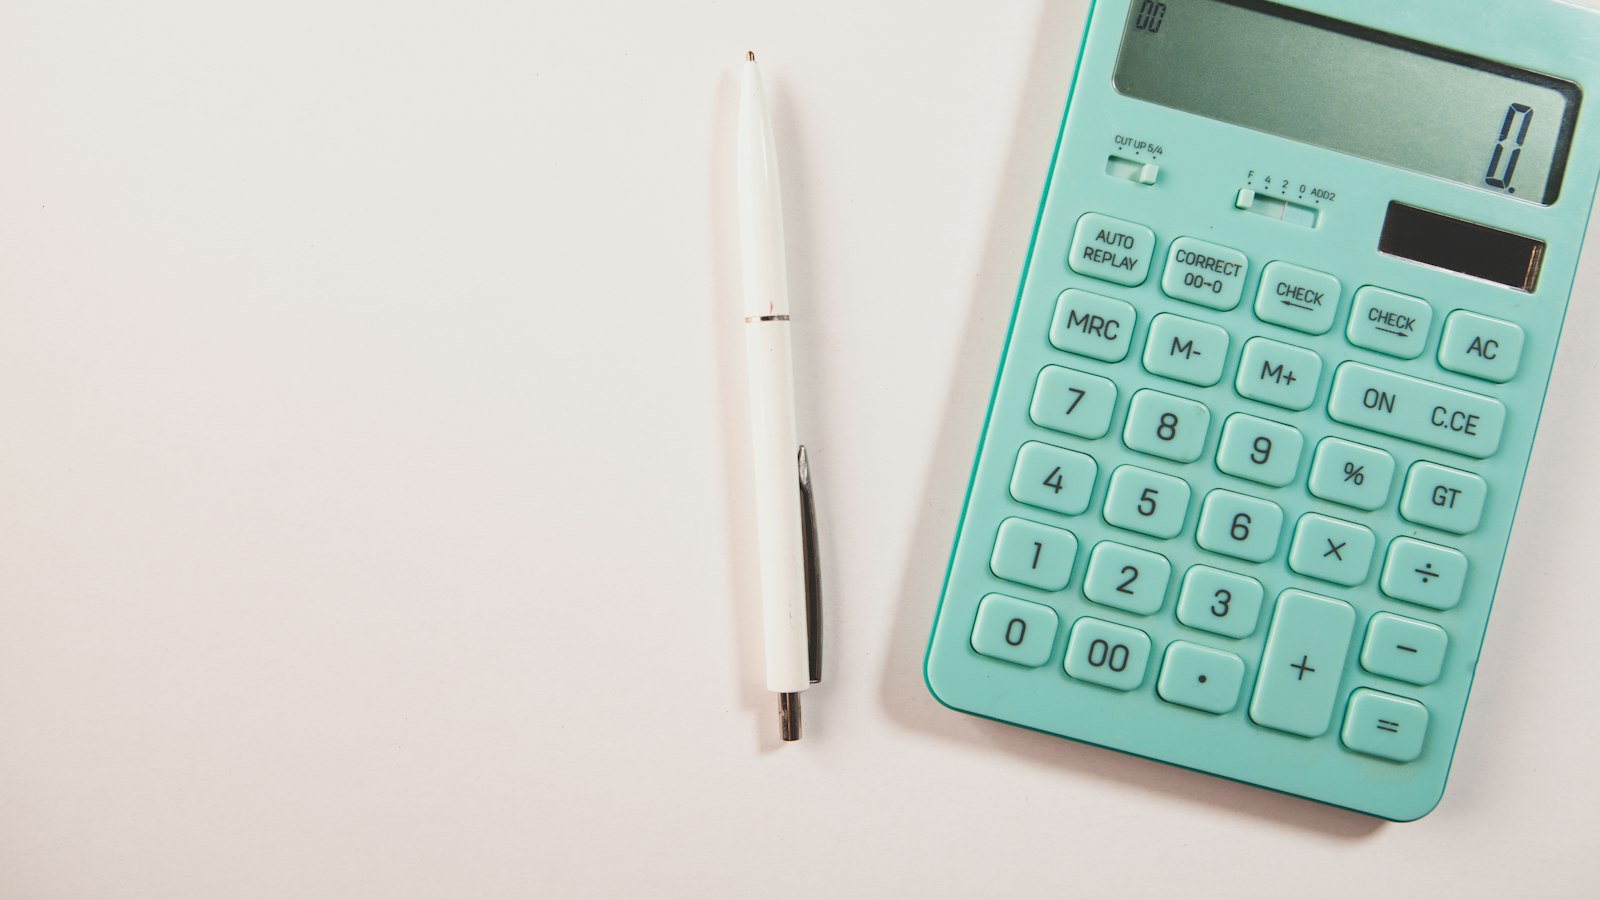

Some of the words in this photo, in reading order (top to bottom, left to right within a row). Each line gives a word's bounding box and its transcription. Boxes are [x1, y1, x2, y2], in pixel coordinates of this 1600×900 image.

[1114, 134, 1133, 147] CUT
[1133, 140, 1147, 149] UP
[1147, 143, 1163, 155] 5/4
[1248, 170, 1255, 178] F
[1265, 175, 1271, 184] 4
[1282, 179, 1289, 189] 2
[1310, 187, 1336, 202] ADD2
[1095, 229, 1135, 250] AUTO
[1082, 246, 1139, 272] REPLAY
[1175, 249, 1243, 278] CORRECT
[1276, 281, 1325, 307] CHECK
[1066, 309, 1120, 342] MRC
[1368, 307, 1416, 332] CHECK
[1169, 336, 1202, 361] M-
[1465, 335, 1499, 361] AC
[1260, 360, 1297, 387] M+
[1065, 387, 1086, 416] 7
[1362, 387, 1396, 414] ON
[1430, 405, 1481, 437] C.CE
[1155, 412, 1179, 442] 8
[1249, 435, 1273, 465] 9
[1042, 466, 1063, 495] 4
[1343, 461, 1365, 487] %
[1136, 487, 1159, 517] 5
[1431, 484, 1463, 510] GT
[1229, 512, 1252, 542] 6
[1031, 541, 1043, 570] 1
[1115, 565, 1139, 595] 2
[1210, 588, 1232, 618] 3
[1004, 617, 1027, 647] 0
[1087, 638, 1130, 673] 00
[1289, 654, 1316, 681] +
